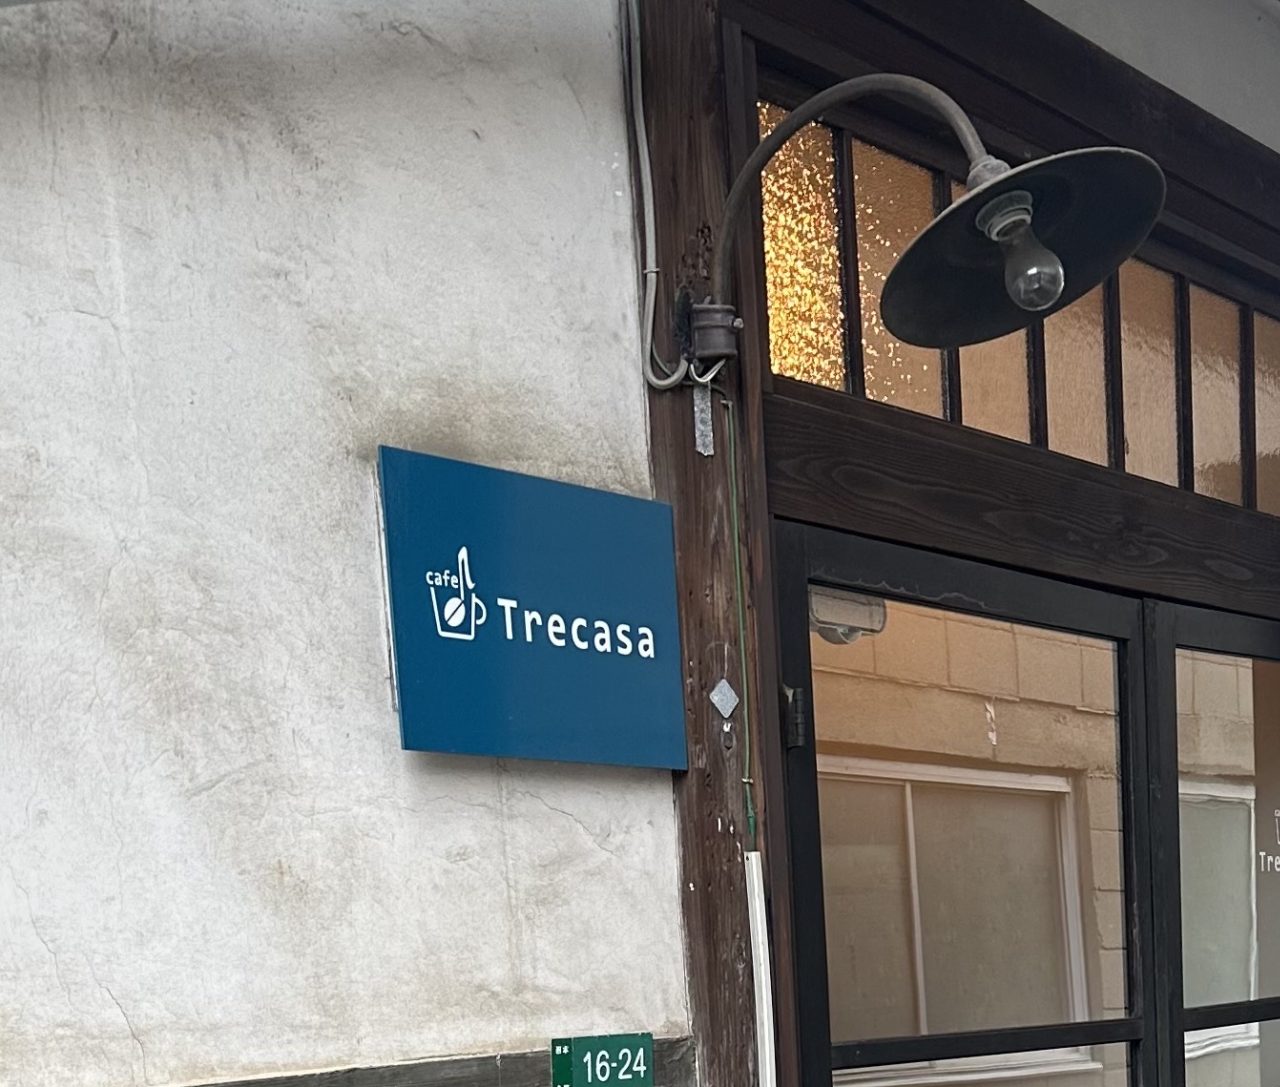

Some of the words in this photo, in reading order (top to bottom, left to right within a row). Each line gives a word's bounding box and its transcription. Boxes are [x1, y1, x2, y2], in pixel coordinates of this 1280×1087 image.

[425, 569, 459, 588] cafe
[497, 597, 655, 659] Trecasa
[583, 1047, 647, 1083] 16-24
